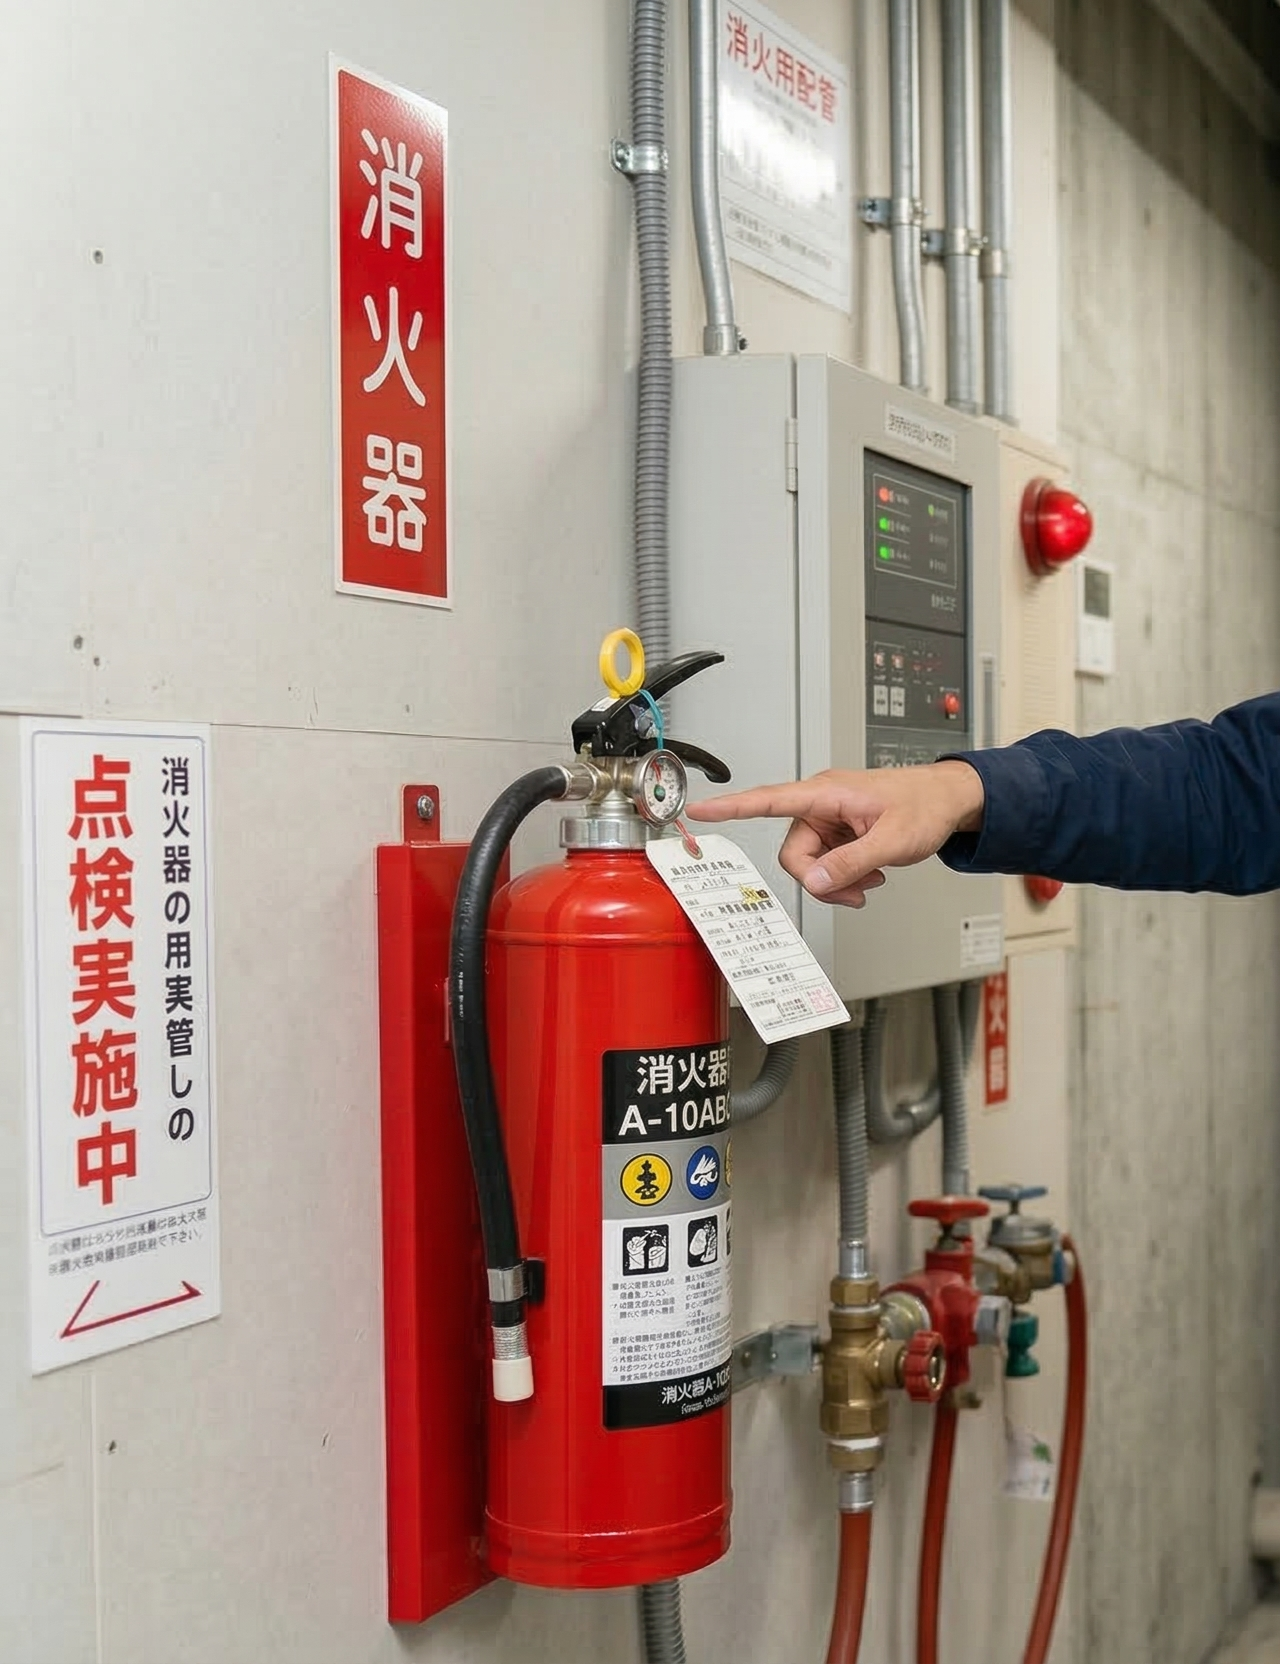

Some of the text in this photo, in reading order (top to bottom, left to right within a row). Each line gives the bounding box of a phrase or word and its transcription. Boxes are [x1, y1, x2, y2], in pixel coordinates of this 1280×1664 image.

[360, 127, 427, 552] 消火器
[67, 753, 138, 1205] 点検実施中
[161, 756, 196, 1143] 消火器の用実管しの
[637, 1046, 731, 1095] 消火器
